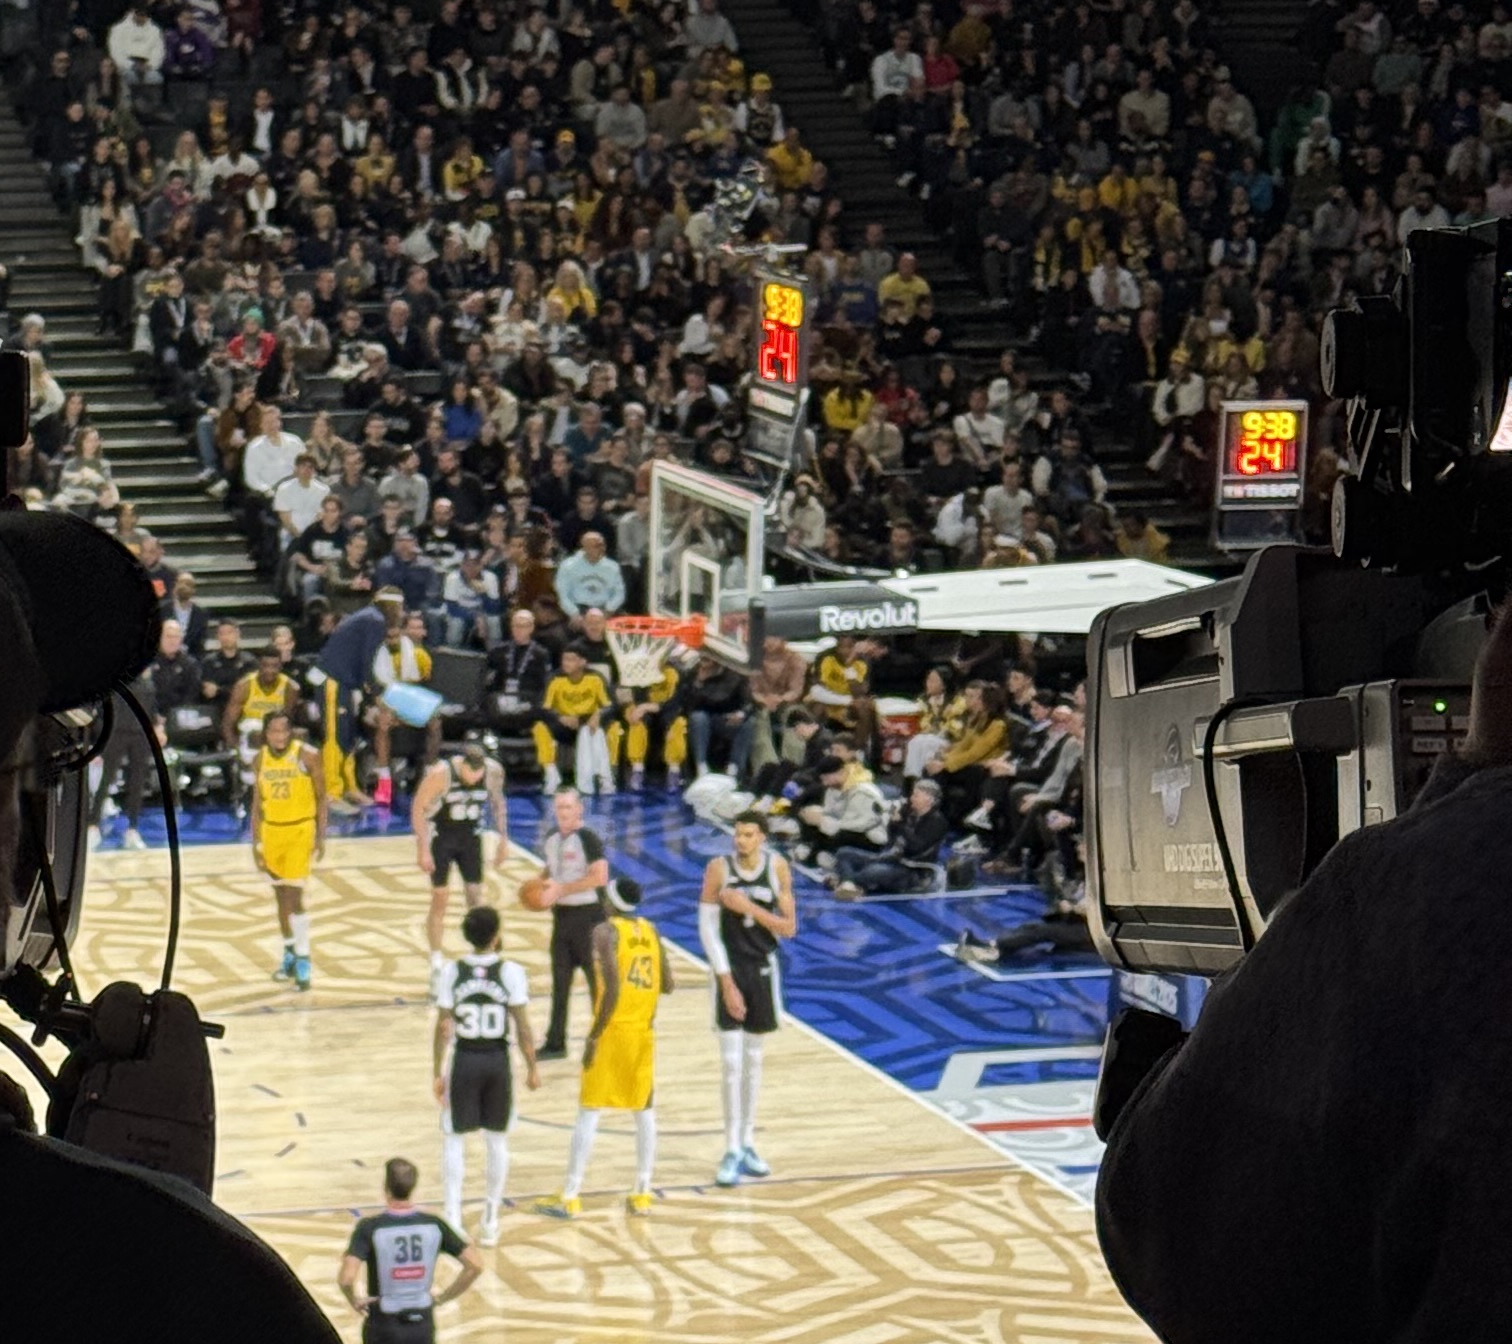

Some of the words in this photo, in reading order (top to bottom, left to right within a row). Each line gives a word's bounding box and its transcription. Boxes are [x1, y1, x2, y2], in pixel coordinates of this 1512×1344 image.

[765, 284, 803, 328] 9:38
[759, 320, 799, 383] 24
[1243, 411, 1296, 440] 9:38
[1238, 440, 1283, 474] 24
[819, 602, 917, 633] Revolut
[627, 956, 653, 989] 43
[455, 1003, 506, 1039] 30
[394, 1234, 423, 1264] 36
